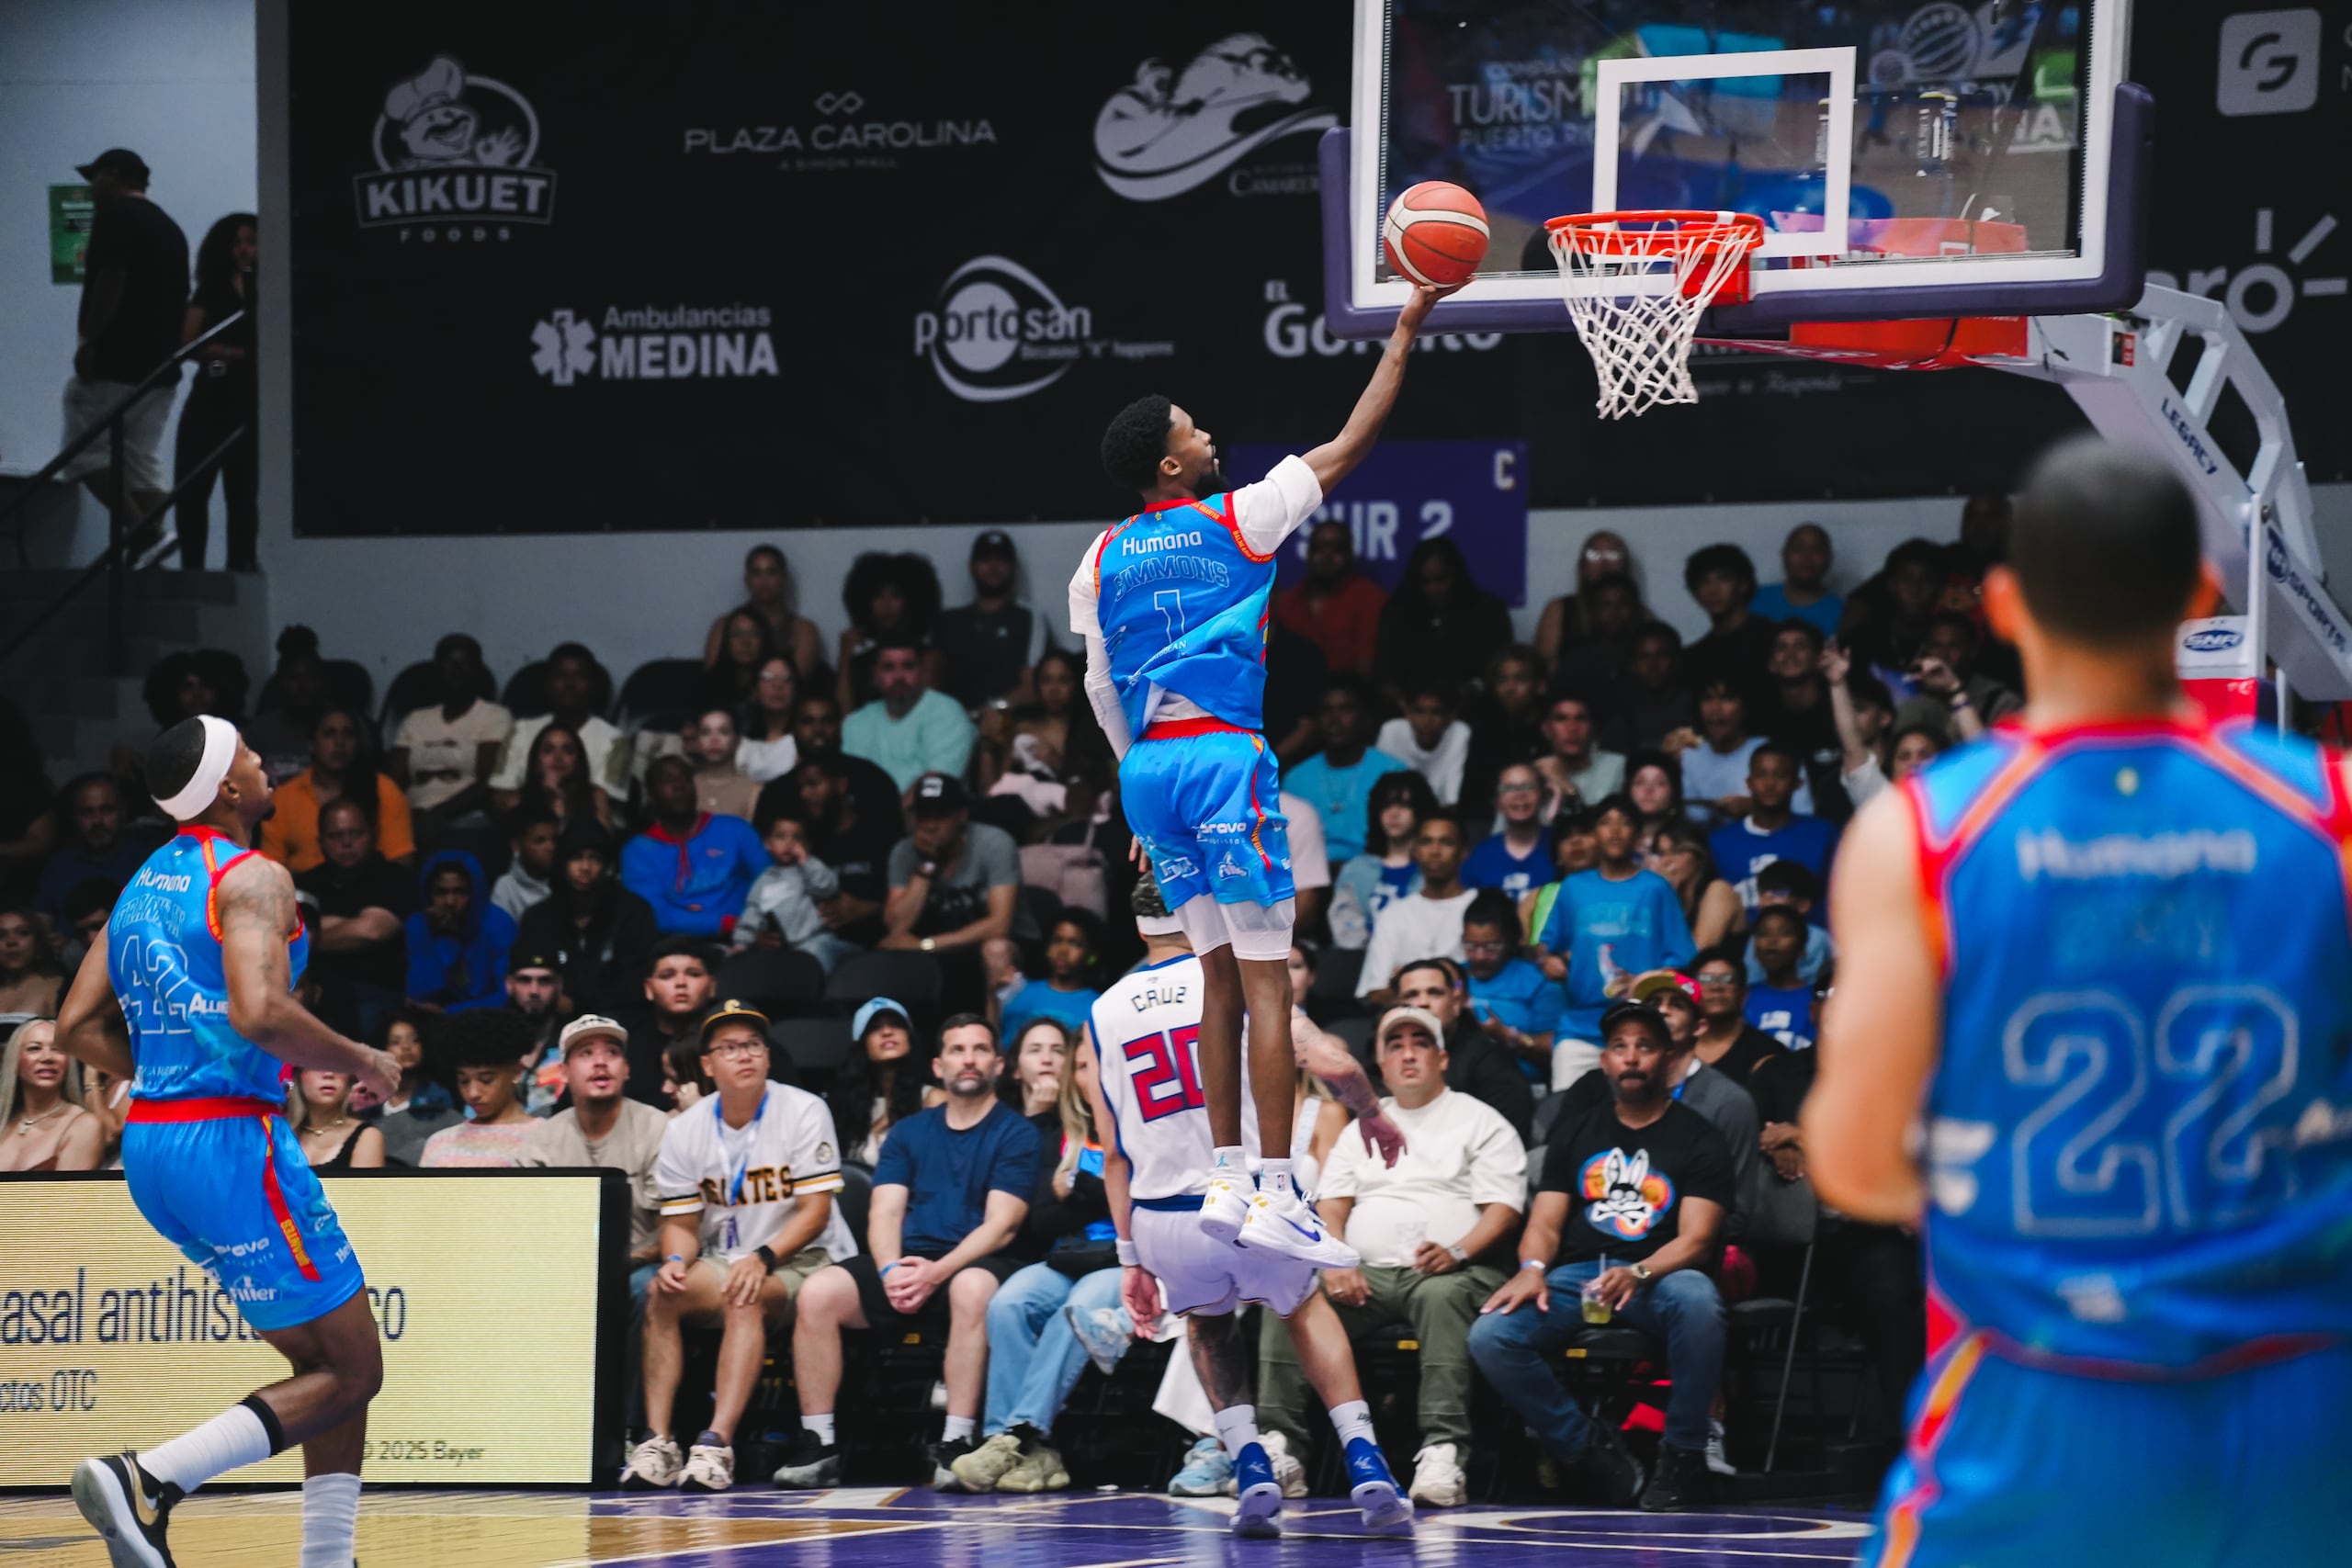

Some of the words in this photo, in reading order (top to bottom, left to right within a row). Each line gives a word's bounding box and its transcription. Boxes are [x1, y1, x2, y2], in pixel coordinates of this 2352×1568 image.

[1448, 78, 1597, 126] TURISM
[684, 126, 803, 153] PLAZA
[810, 118, 997, 151] CAROLINA
[368, 175, 548, 218] KIKUET
[401, 228, 511, 243] FOODS
[1265, 279, 1289, 302] EL
[603, 303, 772, 330] Ambulancias
[914, 305, 1091, 356] portosan
[601, 332, 780, 379] MEDINA
[2161, 396, 2218, 475] LEGACY
[1494, 449, 1515, 491] C
[1420, 500, 1453, 540] 2
[1122, 530, 1203, 557] Humana
[1153, 588, 1186, 644] 1
[2288, 570, 2346, 653] SPORTS
[120, 934, 192, 1035] 42
[1130, 986, 1187, 1012] CRUZ
[1121, 1021, 1206, 1123] 20
[2002, 981, 2300, 1239] 22
[51, 1369, 97, 1413] OTC
[379, 1439, 428, 1461] 2025
[433, 1439, 485, 1468] Bayer
